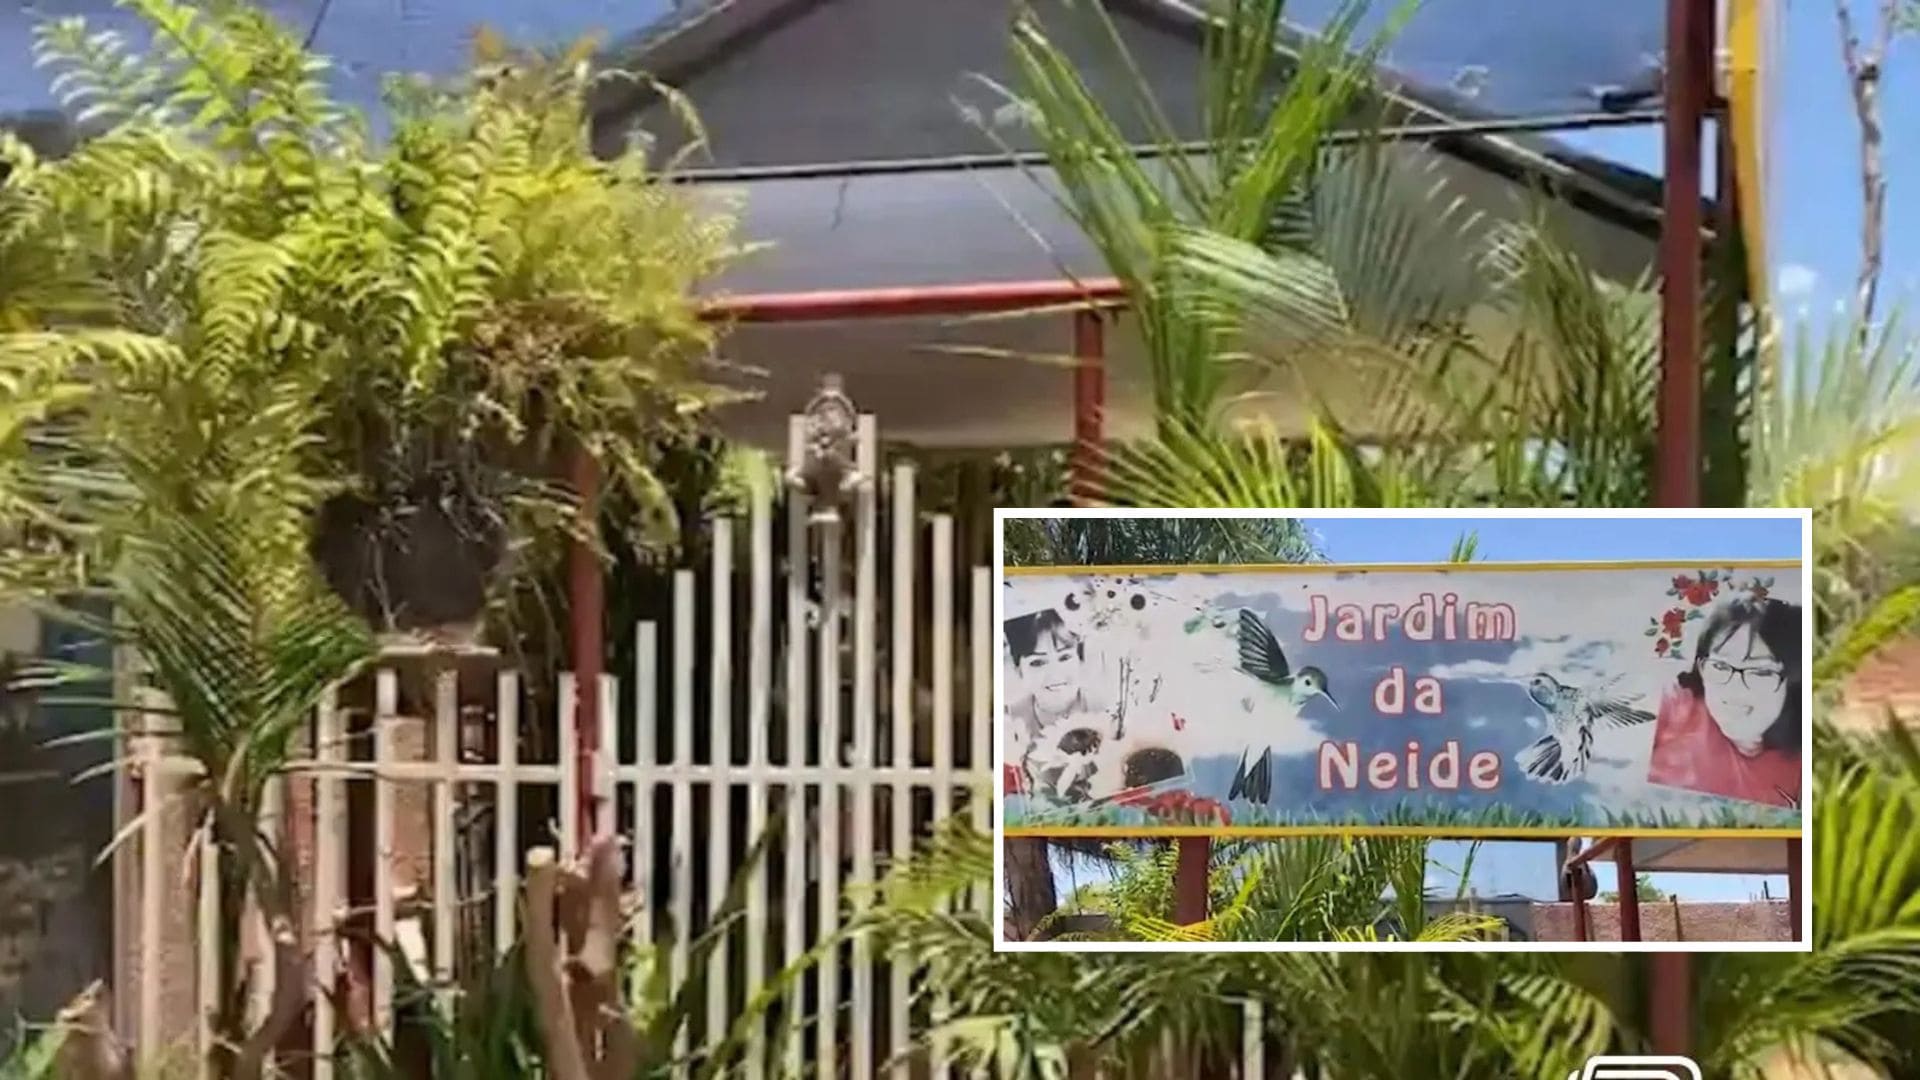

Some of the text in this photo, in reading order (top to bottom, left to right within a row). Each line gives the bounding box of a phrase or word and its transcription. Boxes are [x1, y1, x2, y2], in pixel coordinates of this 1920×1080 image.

[1303, 592, 1517, 642] Jardim
[1374, 664, 1445, 715] da
[1318, 739, 1501, 790] Neide
